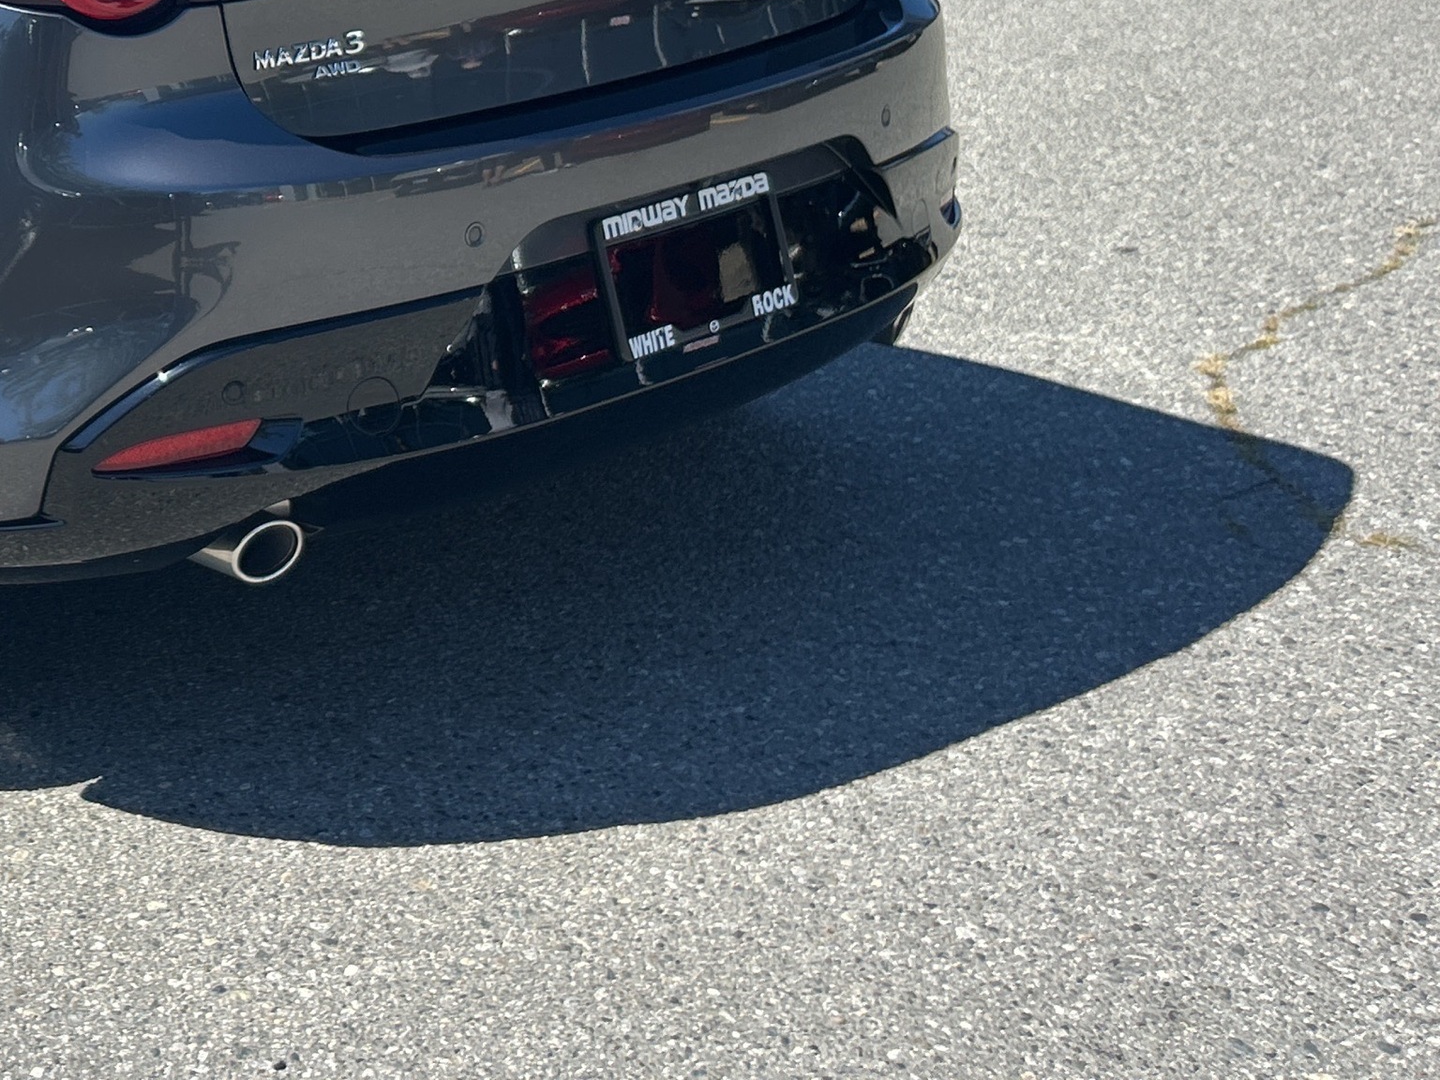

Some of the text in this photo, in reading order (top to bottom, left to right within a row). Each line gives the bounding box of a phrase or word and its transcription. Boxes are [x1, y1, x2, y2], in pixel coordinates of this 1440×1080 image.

[315, 60, 360, 79] AWD
[628, 285, 796, 359] WHITE ROCK
